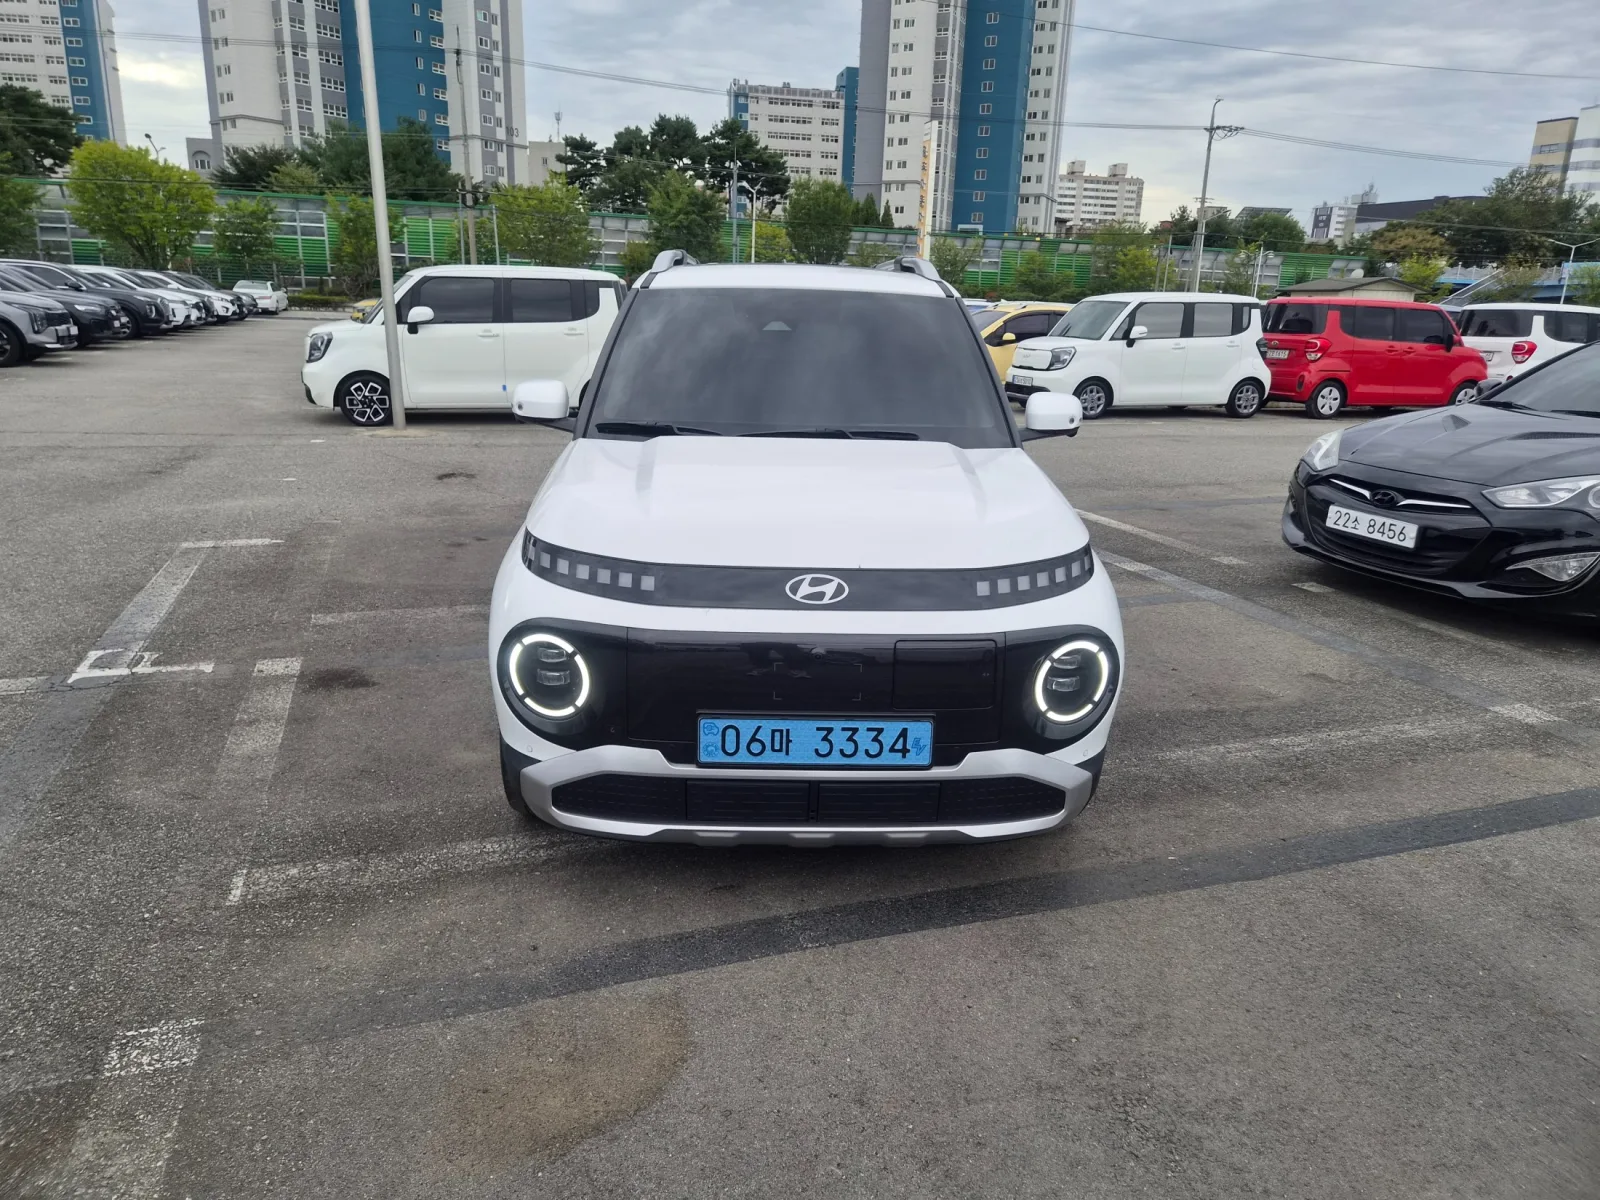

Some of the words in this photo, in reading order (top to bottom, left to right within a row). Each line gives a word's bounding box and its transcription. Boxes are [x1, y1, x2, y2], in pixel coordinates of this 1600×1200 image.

[505, 126, 520, 138] 103
[1333, 510, 1360, 530] 22소
[1366, 518, 1407, 542] 8456
[720, 724, 793, 757] 06마
[814, 726, 911, 759] 3334
